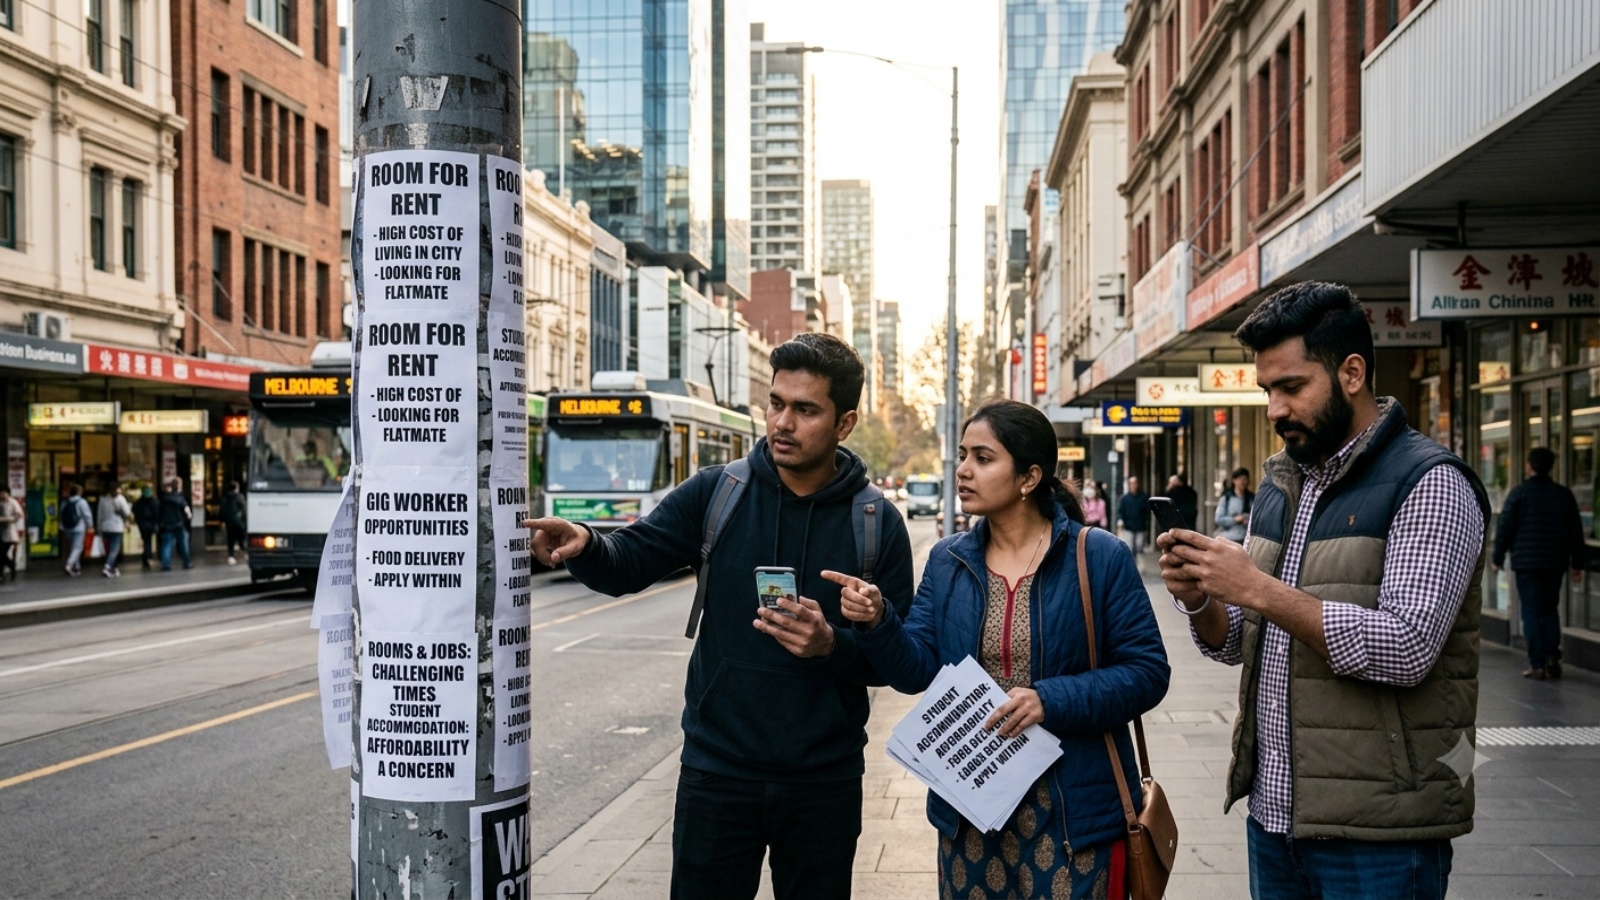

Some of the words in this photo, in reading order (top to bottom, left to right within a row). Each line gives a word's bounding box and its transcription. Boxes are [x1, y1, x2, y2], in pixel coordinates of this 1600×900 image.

[372, 162, 423, 187] ROOM
[430, 163, 468, 187] FOR
[392, 193, 441, 215] RENT
[380, 226, 406, 240] HIGH
[410, 225, 444, 240] COST
[448, 227, 463, 241] OF
[375, 245, 411, 260] LIVING
[415, 246, 428, 259] IN
[432, 246, 462, 260] CITY
[381, 266, 432, 280] LOOKING
[436, 266, 460, 280] FOR
[386, 285, 448, 299] FLATMATE
[369, 323, 420, 346] ROOM
[427, 323, 465, 346] FOR
[388, 354, 438, 376] RENT
[265, 378, 338, 395] MELBOURNE
[377, 388, 404, 401] HIGH
[408, 387, 442, 402] COST
[446, 388, 461, 402] OF
[379, 408, 430, 422] LOOKING
[435, 408, 459, 422] FOR
[384, 428, 446, 442] FLATMATE
[367, 493, 389, 511] GIG
[394, 493, 467, 512] WORKER
[365, 519, 468, 535] OPPORTUNITIES
[373, 551, 401, 565] FOOD
[405, 552, 465, 565] DELIVERY
[375, 573, 409, 587] APPLY
[413, 574, 461, 587] WITHIN
[369, 641, 413, 659] ROOMS
[417, 646, 426, 659] &
[431, 643, 471, 659] JOBS:
[373, 663, 464, 681] CHALLENGING
[393, 686, 436, 702] TIMES
[390, 703, 441, 717] STUDENT
[368, 737, 469, 756] AFFORDABILITY
[378, 761, 385, 776] A
[389, 762, 454, 778] CONCERN
